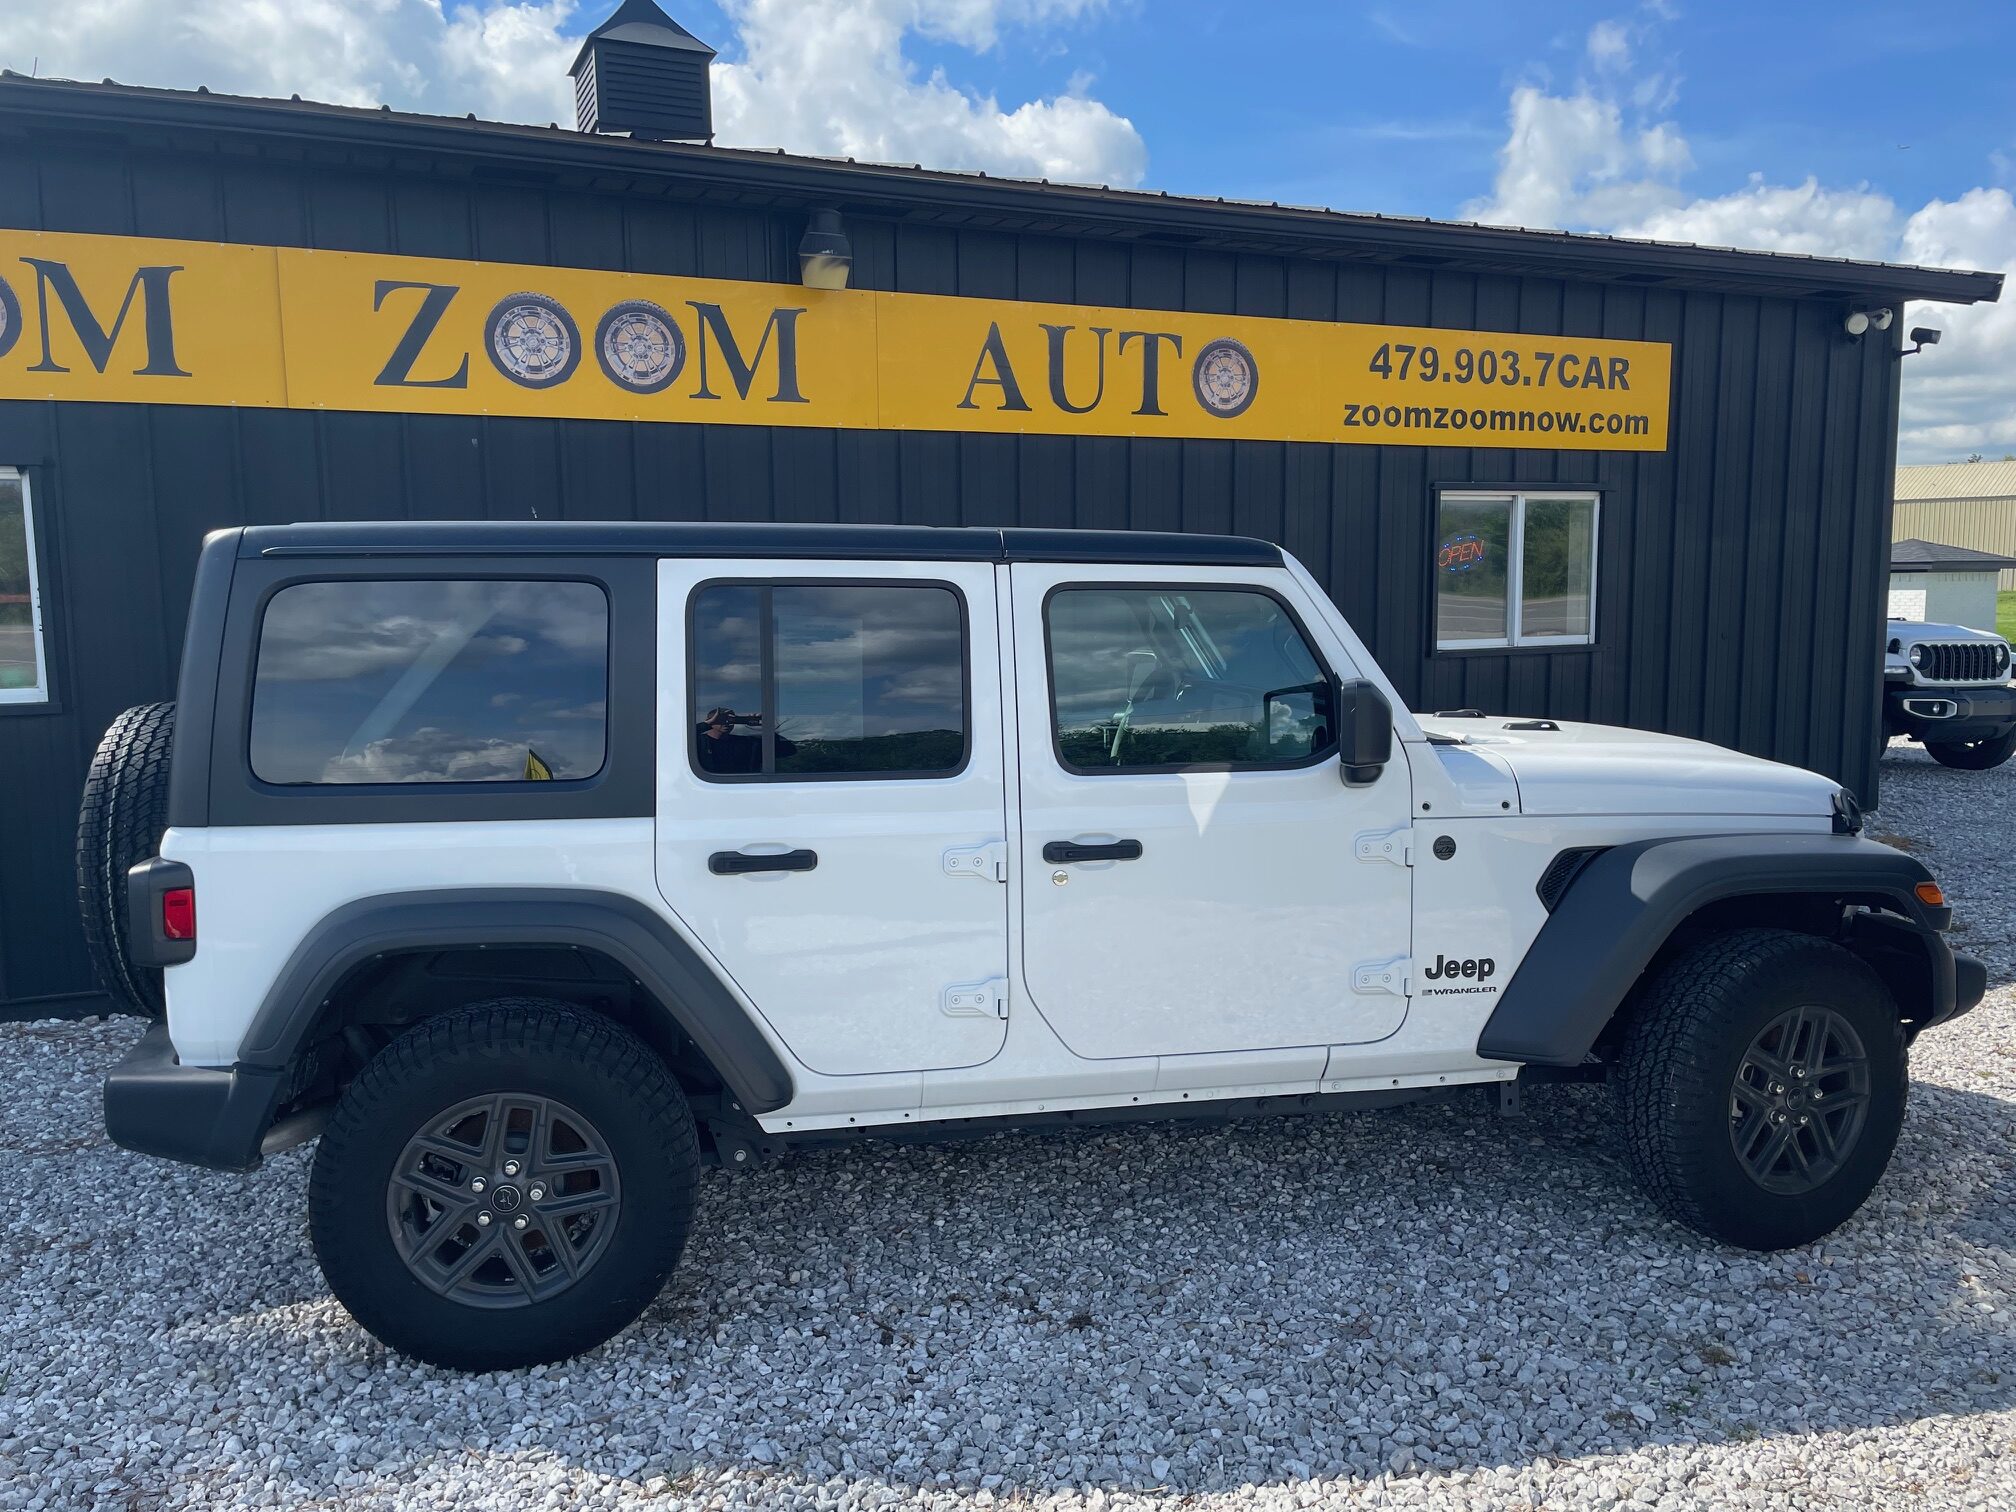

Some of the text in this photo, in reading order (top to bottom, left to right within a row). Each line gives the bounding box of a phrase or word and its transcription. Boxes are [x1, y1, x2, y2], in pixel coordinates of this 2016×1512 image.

[0, 257, 193, 377] M
[956, 321, 1259, 418] AUTO
[1369, 342, 1631, 392] 479.903.7CAR
[1342, 403, 1649, 436] zoomzoomnow.com
[1438, 539, 1484, 567] OPEN
[1425, 954, 1495, 982] Jeep
[1434, 986, 1497, 995] WRANGLER
